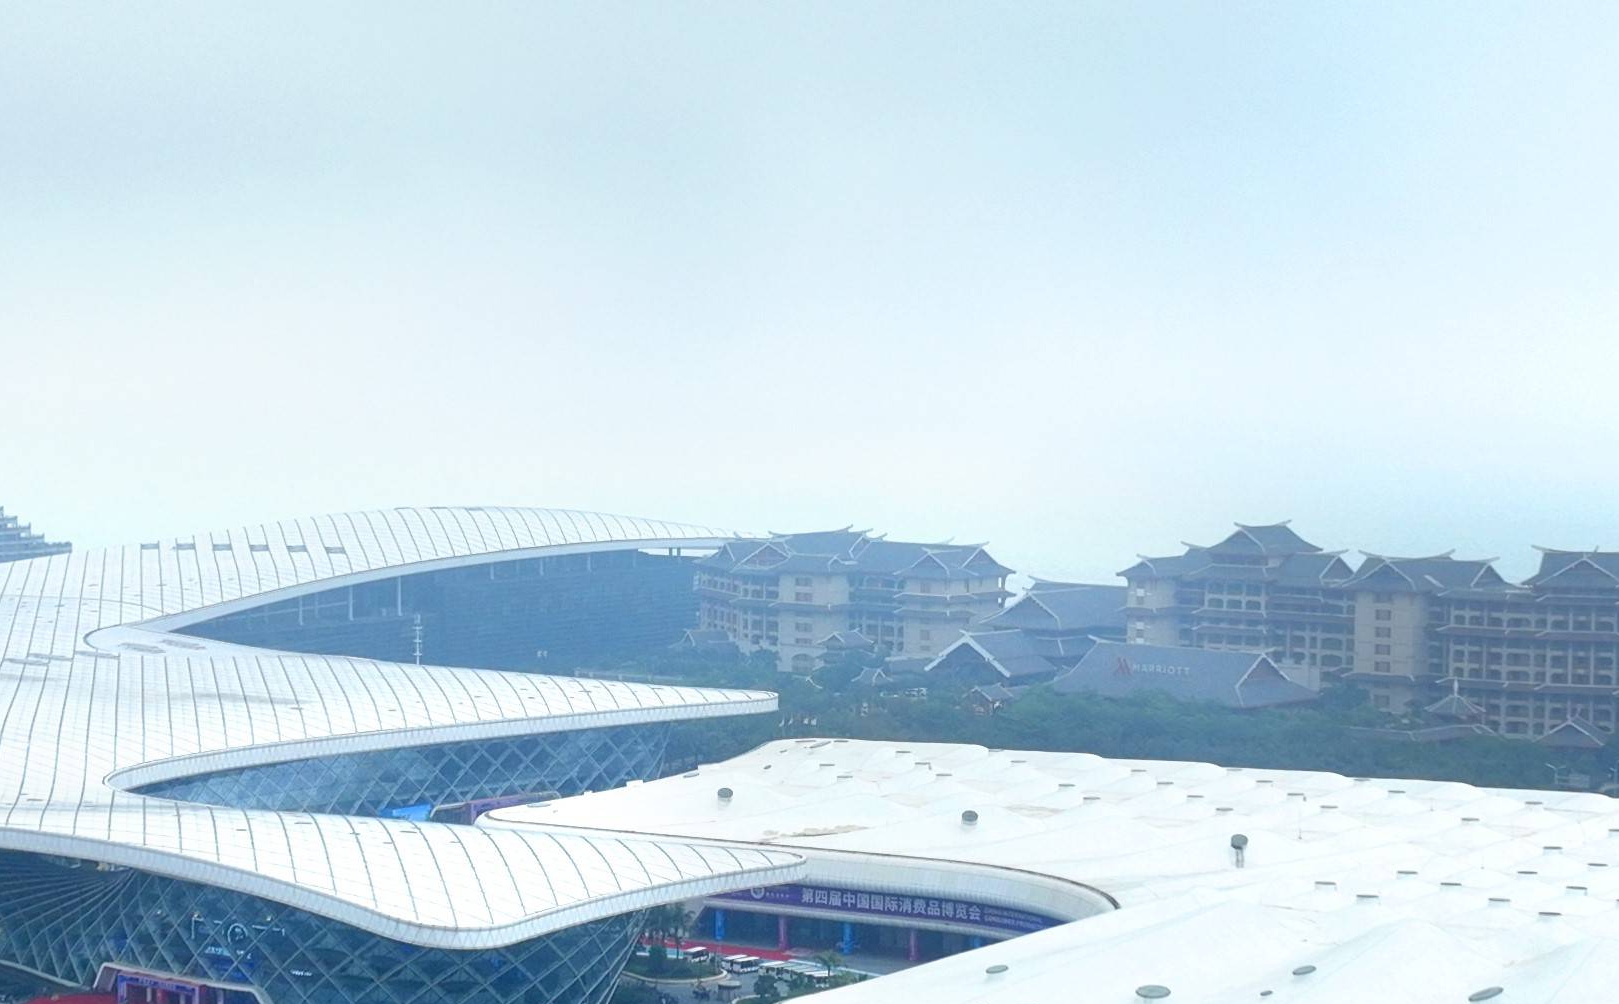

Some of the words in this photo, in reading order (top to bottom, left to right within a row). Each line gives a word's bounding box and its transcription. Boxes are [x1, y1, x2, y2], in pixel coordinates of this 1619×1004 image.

[800, 887, 982, 921] 第四届中国国际消费品博览会
